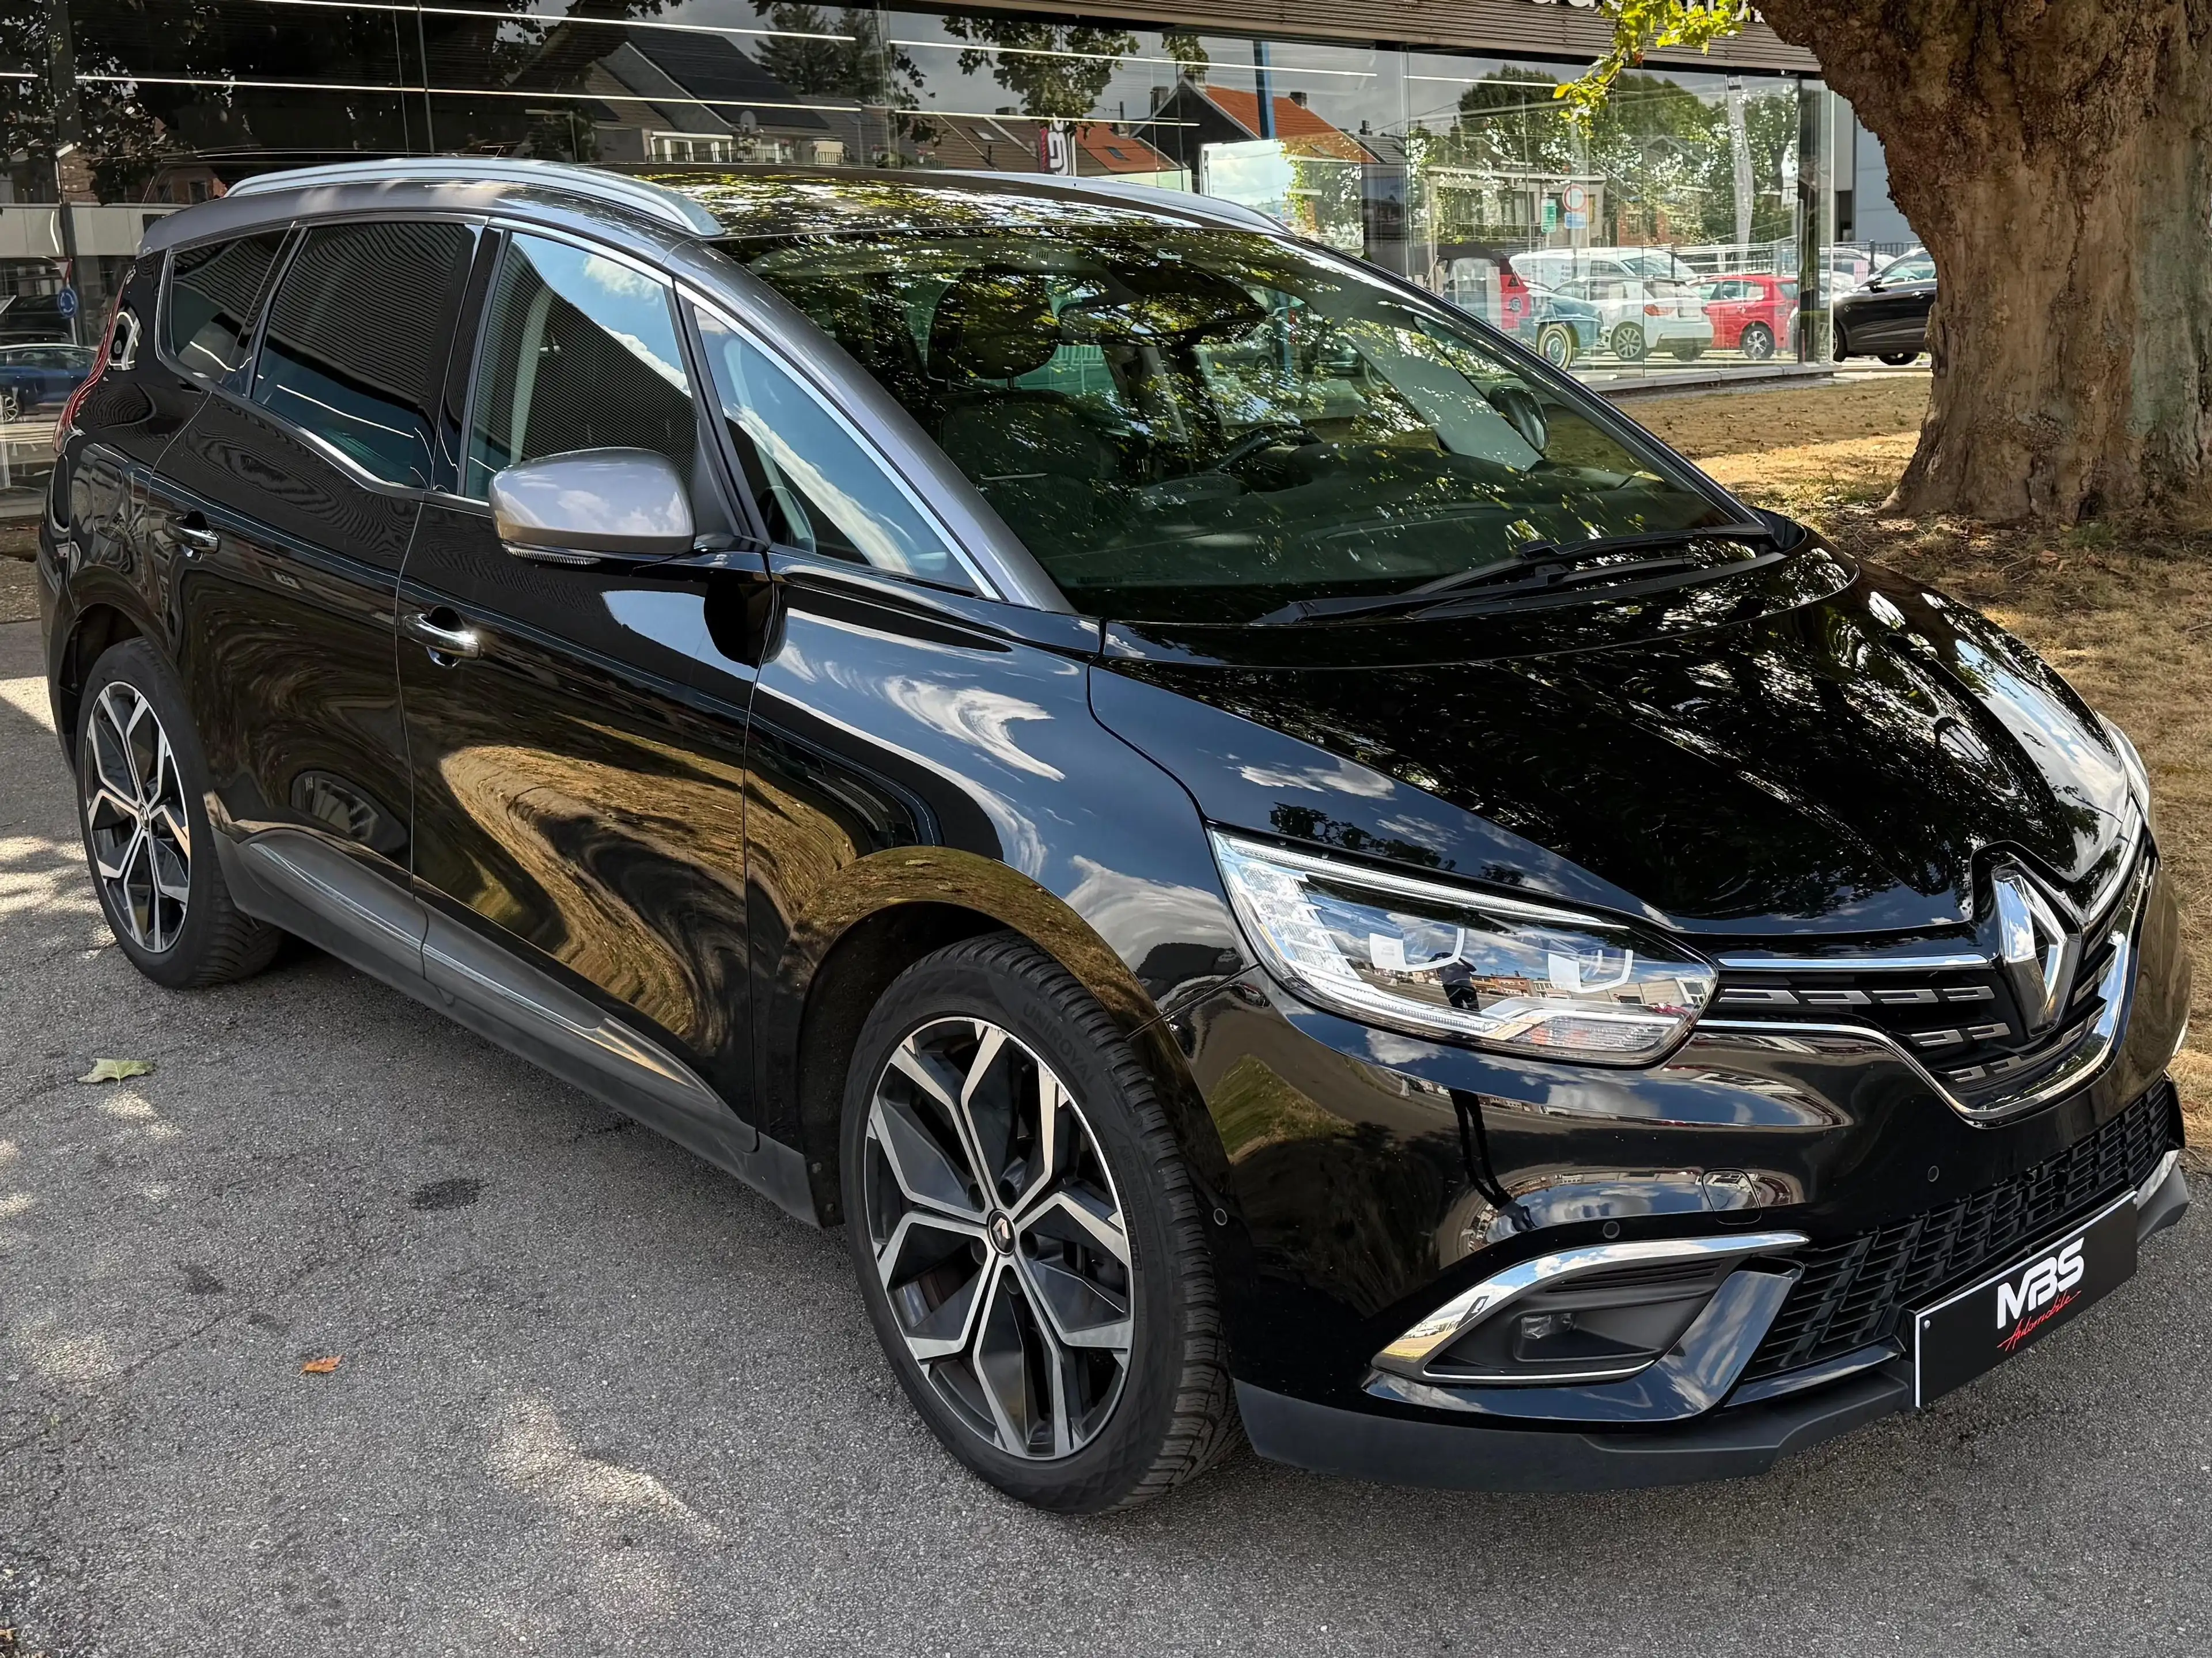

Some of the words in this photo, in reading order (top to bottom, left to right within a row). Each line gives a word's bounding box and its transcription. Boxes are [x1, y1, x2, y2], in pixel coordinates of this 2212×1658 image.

[1024, 1002, 1095, 1084] UNIROYAL
[1131, 1245, 1141, 1270] M+S
[1997, 1237, 2084, 1329] MBS
